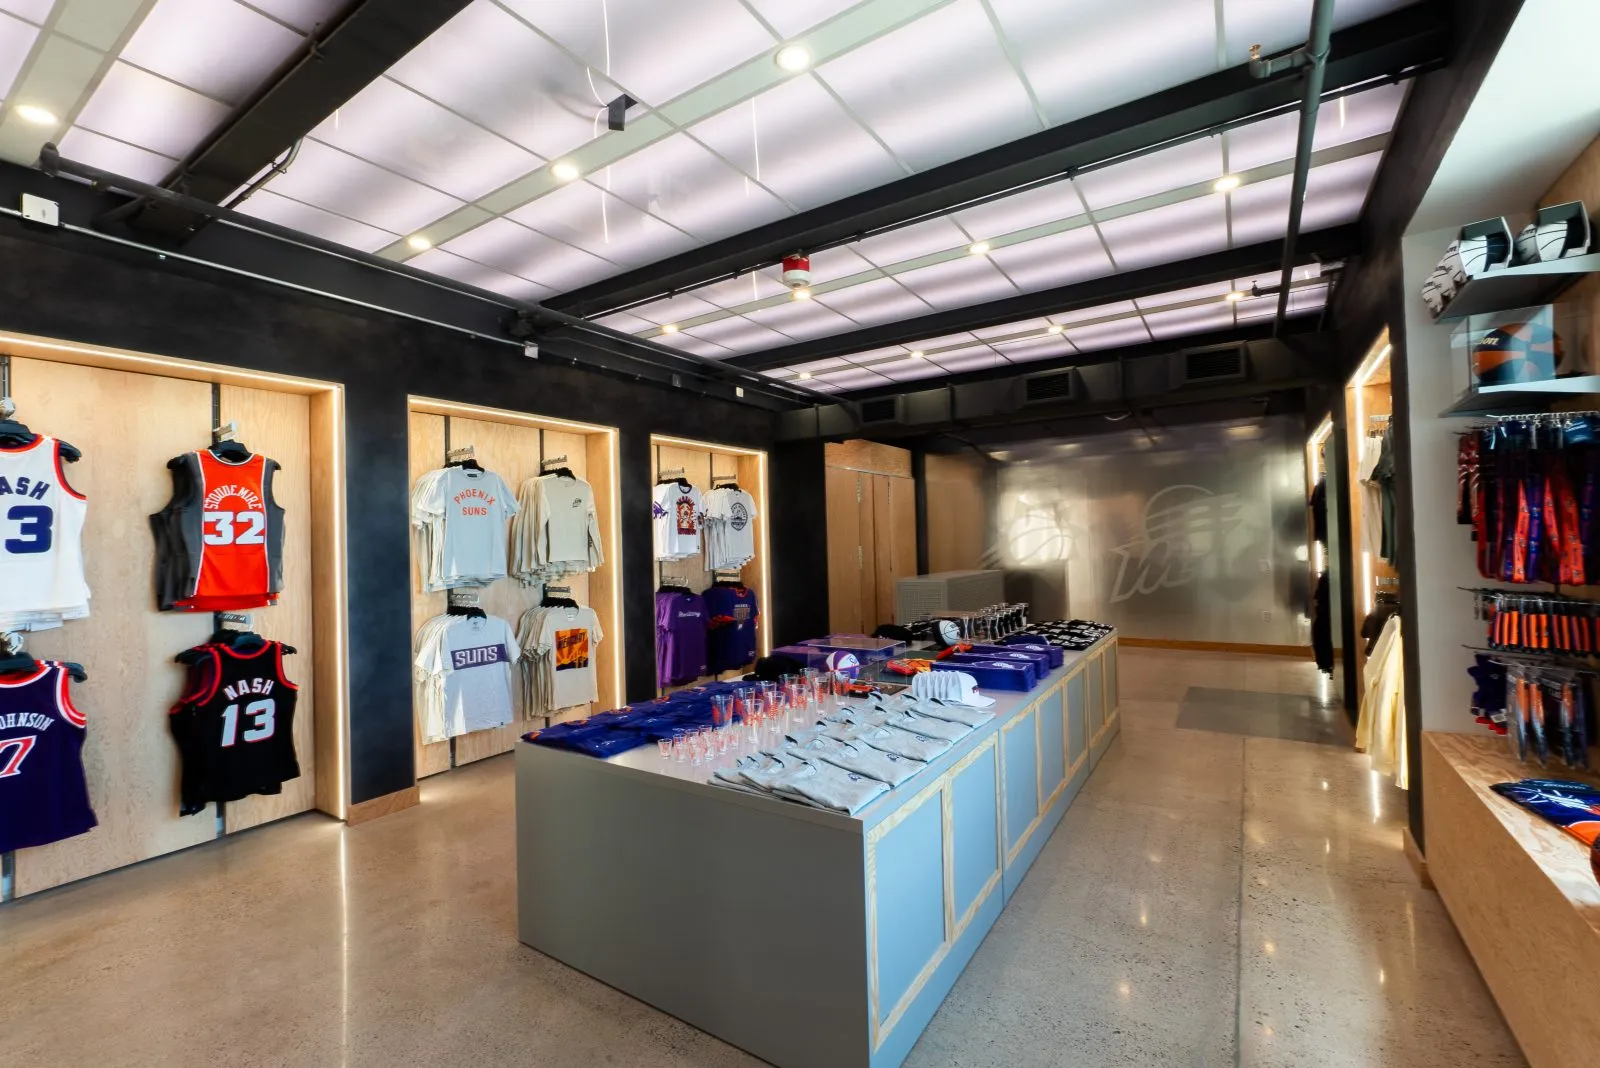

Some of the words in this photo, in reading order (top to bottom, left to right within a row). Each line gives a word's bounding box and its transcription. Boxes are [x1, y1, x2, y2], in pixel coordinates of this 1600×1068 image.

[0, 476, 50, 500] ASH
[204, 485, 262, 509] STOUDEMIRE
[453, 488, 495, 506] PHOENIX
[462, 507, 487, 516] SUNS
[203, 511, 265, 545] 32
[223, 678, 275, 700] NASH
[0, 712, 55, 731] OHNSON
[221, 698, 276, 748] 13
[0, 735, 37, 778] 7
